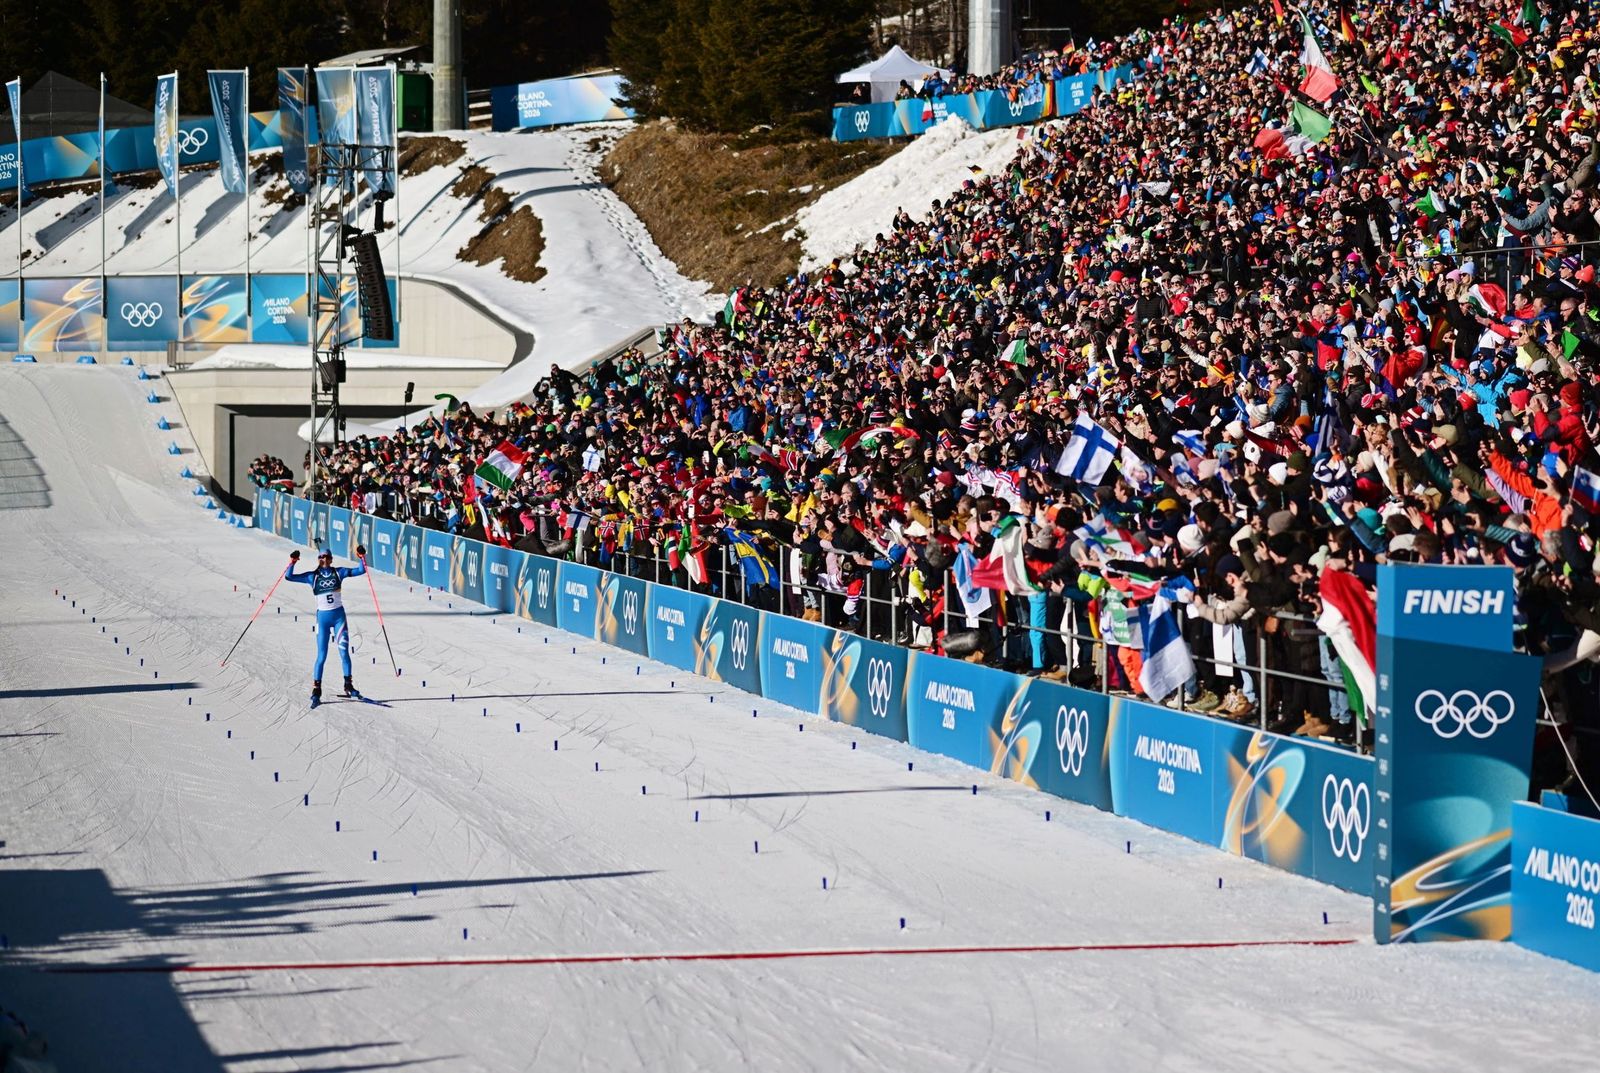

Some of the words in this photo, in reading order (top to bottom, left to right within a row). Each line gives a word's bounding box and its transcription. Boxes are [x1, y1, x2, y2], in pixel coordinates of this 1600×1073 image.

[326, 594, 335, 604] 5
[1403, 589, 1505, 615] FINISH
[925, 680, 950, 705] MILANO
[949, 686, 976, 712] CORTINA
[1134, 734, 1166, 764] MILANO
[1166, 742, 1202, 775] CORTINA
[1158, 767, 1175, 795] 2026
[1523, 845, 1580, 889] MILANO
[1566, 892, 1595, 930] 2026
